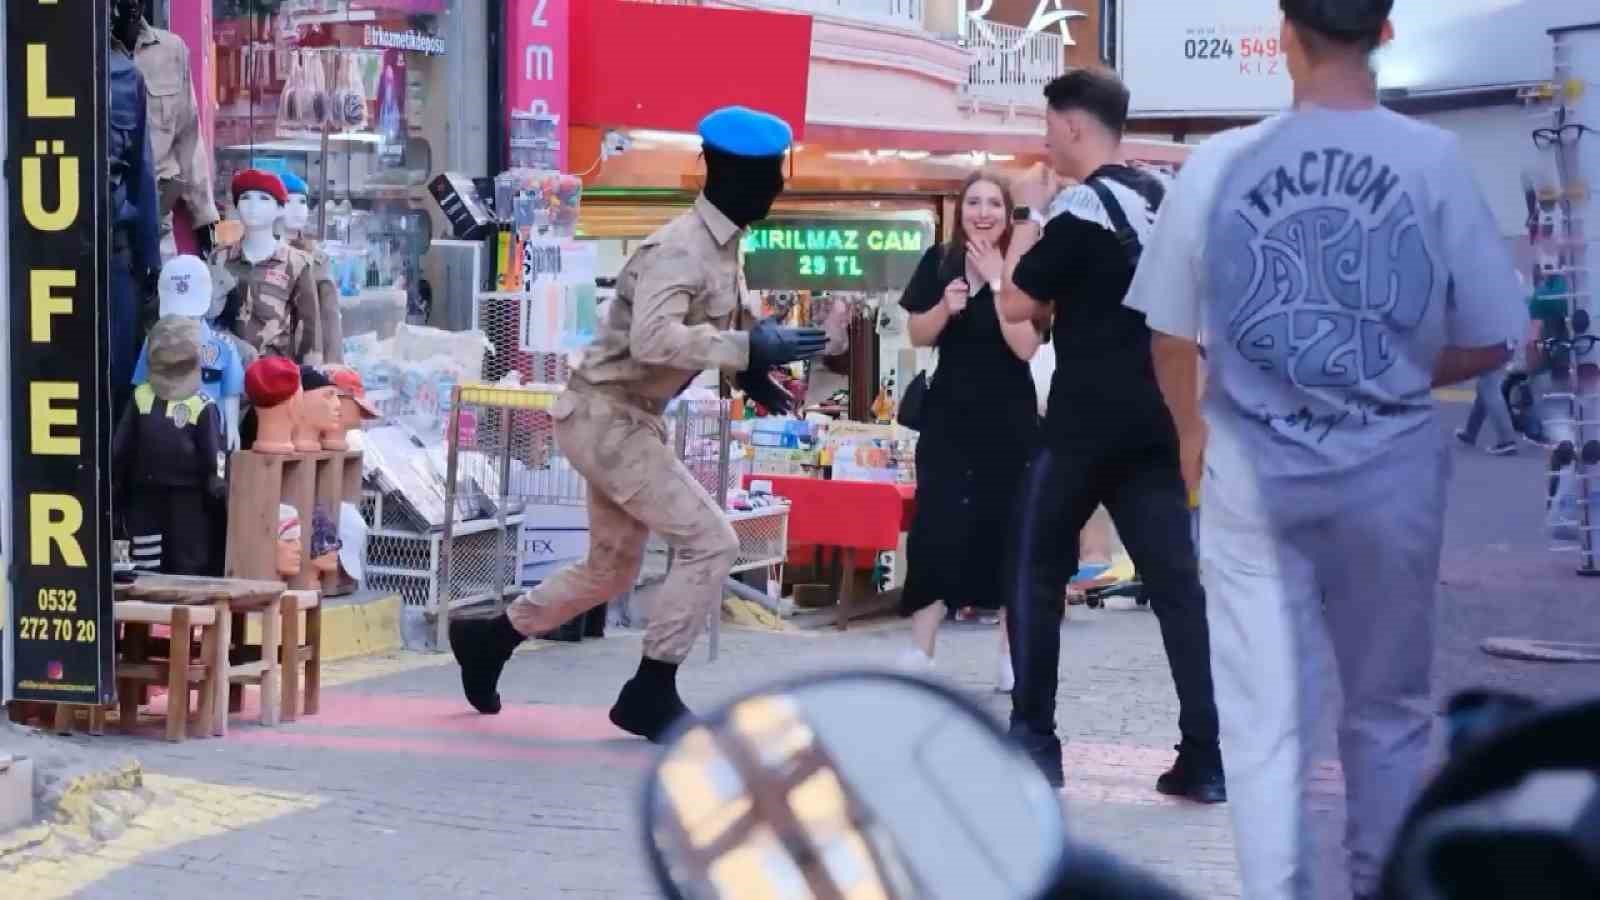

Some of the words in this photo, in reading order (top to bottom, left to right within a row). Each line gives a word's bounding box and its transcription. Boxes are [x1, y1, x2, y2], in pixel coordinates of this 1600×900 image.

[1184, 38, 1234, 59] 0224
[746, 228, 860, 252] KIRILMAZ
[866, 228, 922, 252] CAM
[799, 254, 827, 276] 29
[834, 254, 864, 277] TL
[22, 0, 87, 567] LÜFER
[38, 587, 77, 612] 0532
[20, 616, 49, 640] 272
[53, 618, 73, 641] 70
[76, 619, 96, 643] 20
